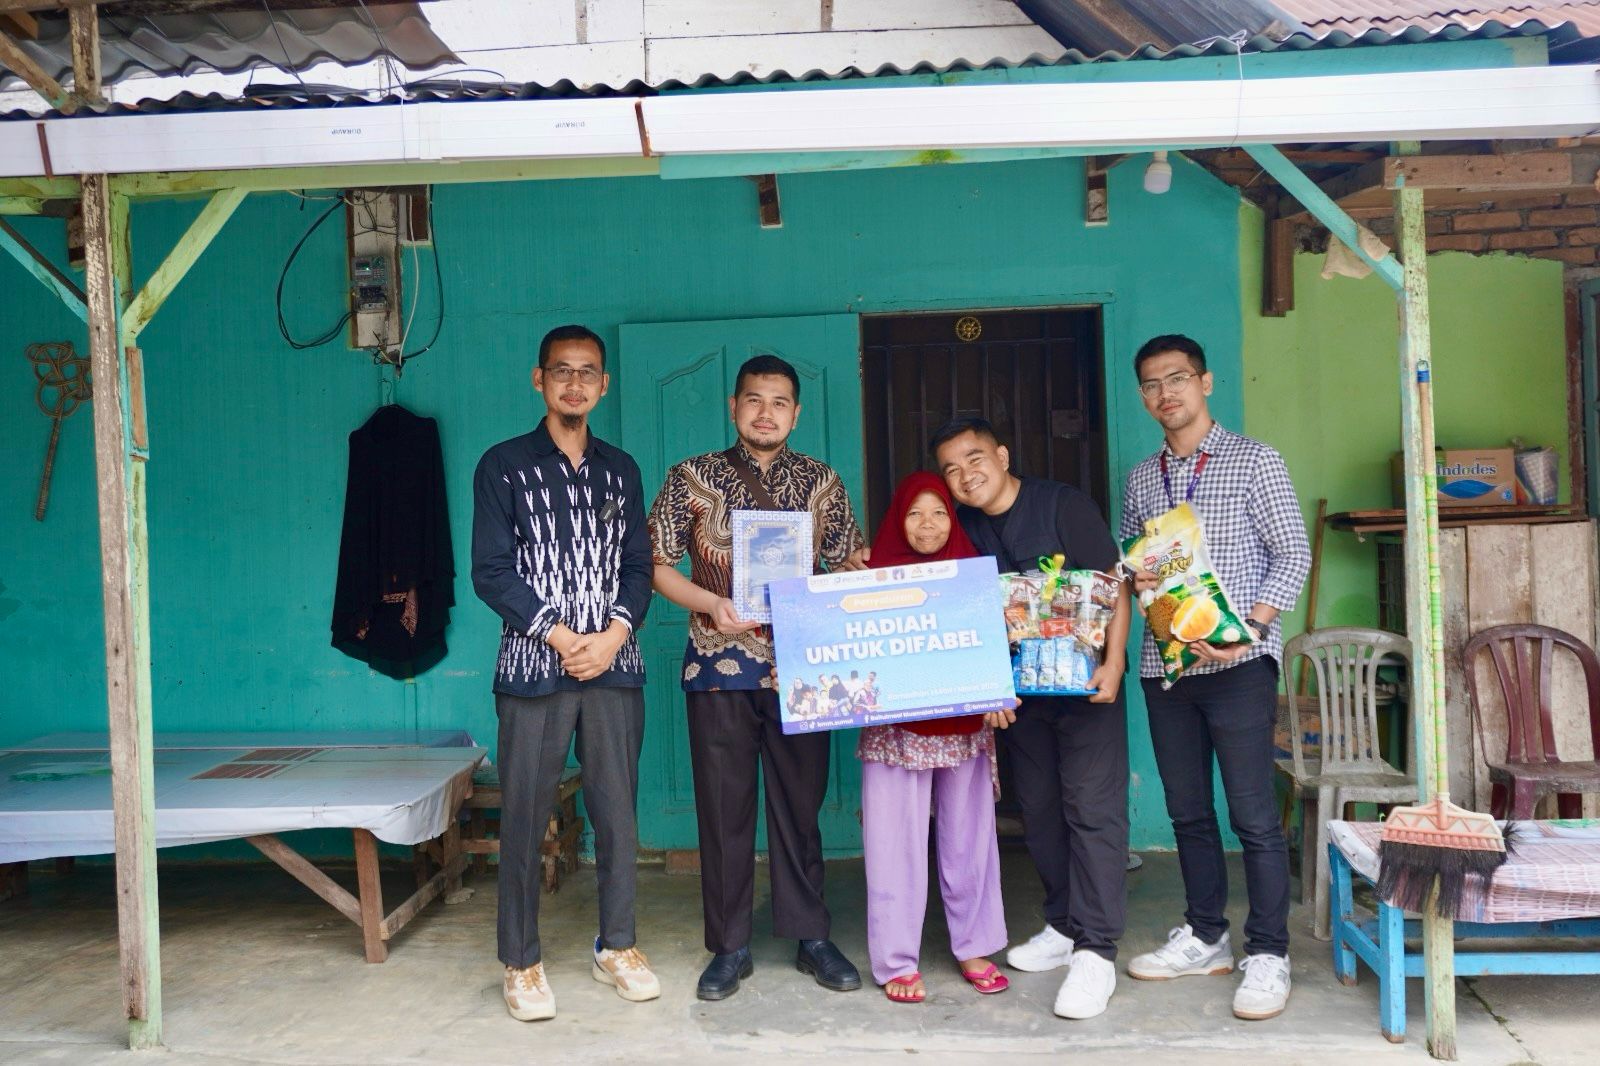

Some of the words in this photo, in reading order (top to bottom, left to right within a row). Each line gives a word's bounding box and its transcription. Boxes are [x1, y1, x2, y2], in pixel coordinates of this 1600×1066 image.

[846, 613, 937, 639] HADIAH
[806, 643, 885, 665] UNTUK
[889, 630, 983, 654] DIFABEL
